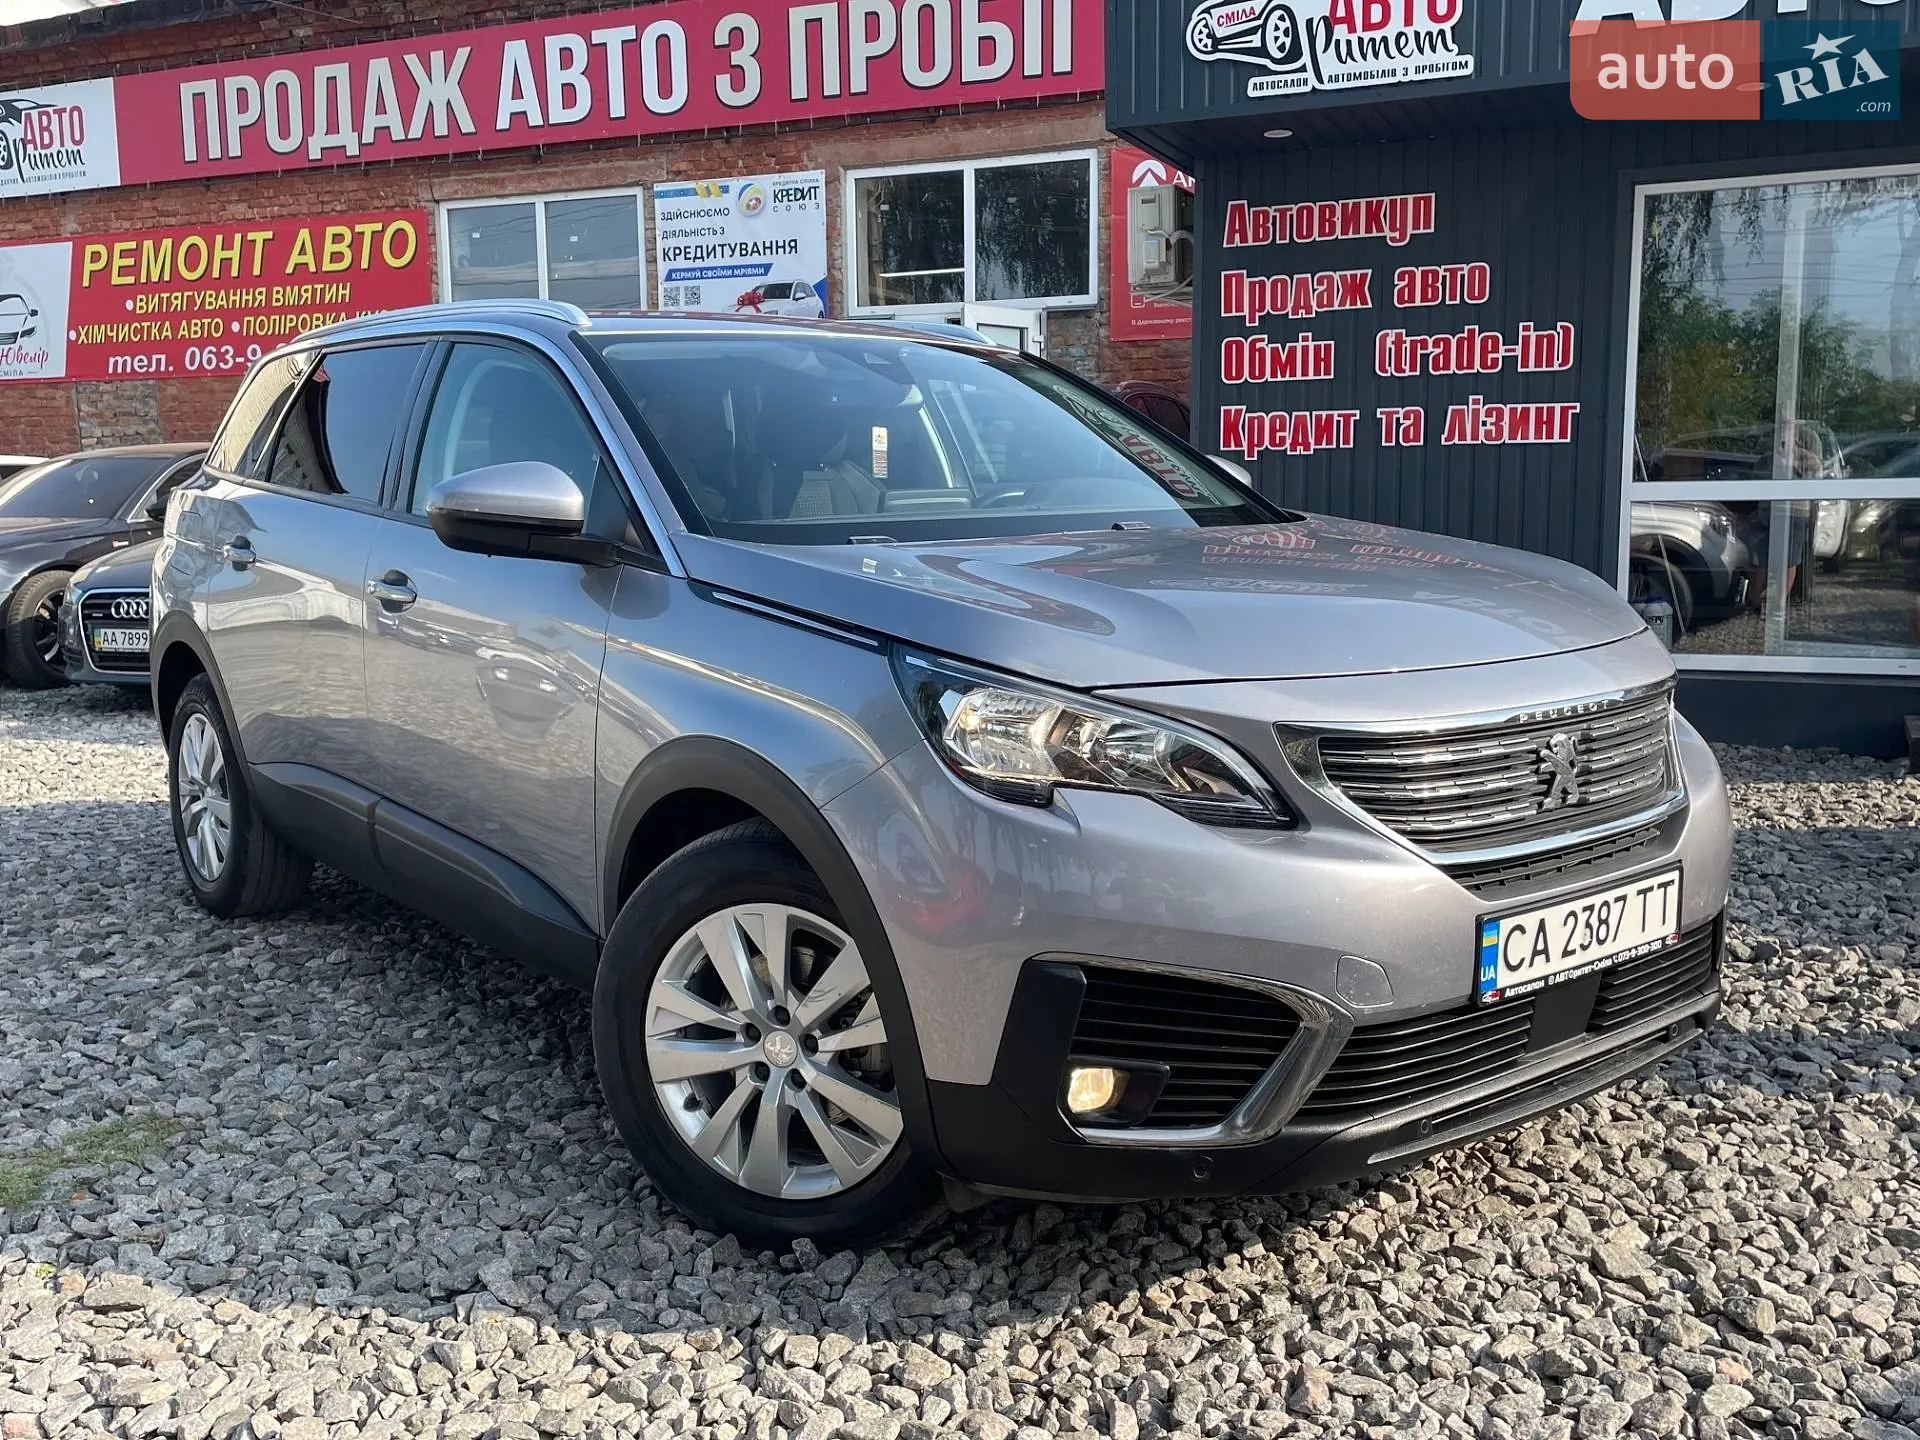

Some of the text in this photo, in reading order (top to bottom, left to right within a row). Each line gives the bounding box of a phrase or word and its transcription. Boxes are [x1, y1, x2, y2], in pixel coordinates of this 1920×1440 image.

[1217, 7, 1256, 27] СМІЛА
[179, 46, 477, 162] ПРОДАЖ
[495, 19, 690, 131] АВТО
[713, 12, 762, 108] З
[1252, 60, 1469, 92] АВТОСАЛОН АВТОМОБІЛІВ З ПРОБІГОМ
[23, 105, 85, 151] АВТО
[660, 207, 730, 221] ЗДІЙСНЮЄМО
[1223, 193, 1436, 248] Автовикуп
[661, 227, 718, 240] ДІЯЛЬНІСТЬ
[82, 219, 417, 287] РЕМОНТ АВТО
[662, 239, 798, 263] КРЕДИТУВАННЯ
[671, 267, 765, 280] КЕРМУЙ СВОЇМИ МРІЯМИ
[136, 283, 351, 314] ВИТЯГУВАННЯ ВМЯТИН
[1221, 262, 1490, 326] Продаж авто
[78, 321, 172, 344] ХІМЧИСТКА
[177, 318, 224, 341] АВТО
[108, 354, 174, 374] тел.
[1220, 322, 1576, 384] Обмін (trade-in)
[1219, 396, 1581, 459] Кредит та лізинг
[102, 631, 149, 647] AA 7899
[1503, 879, 1675, 973] CA 2387 TT
[1481, 966, 1496, 982] UA
[1505, 980, 1544, 998] Автосалон
